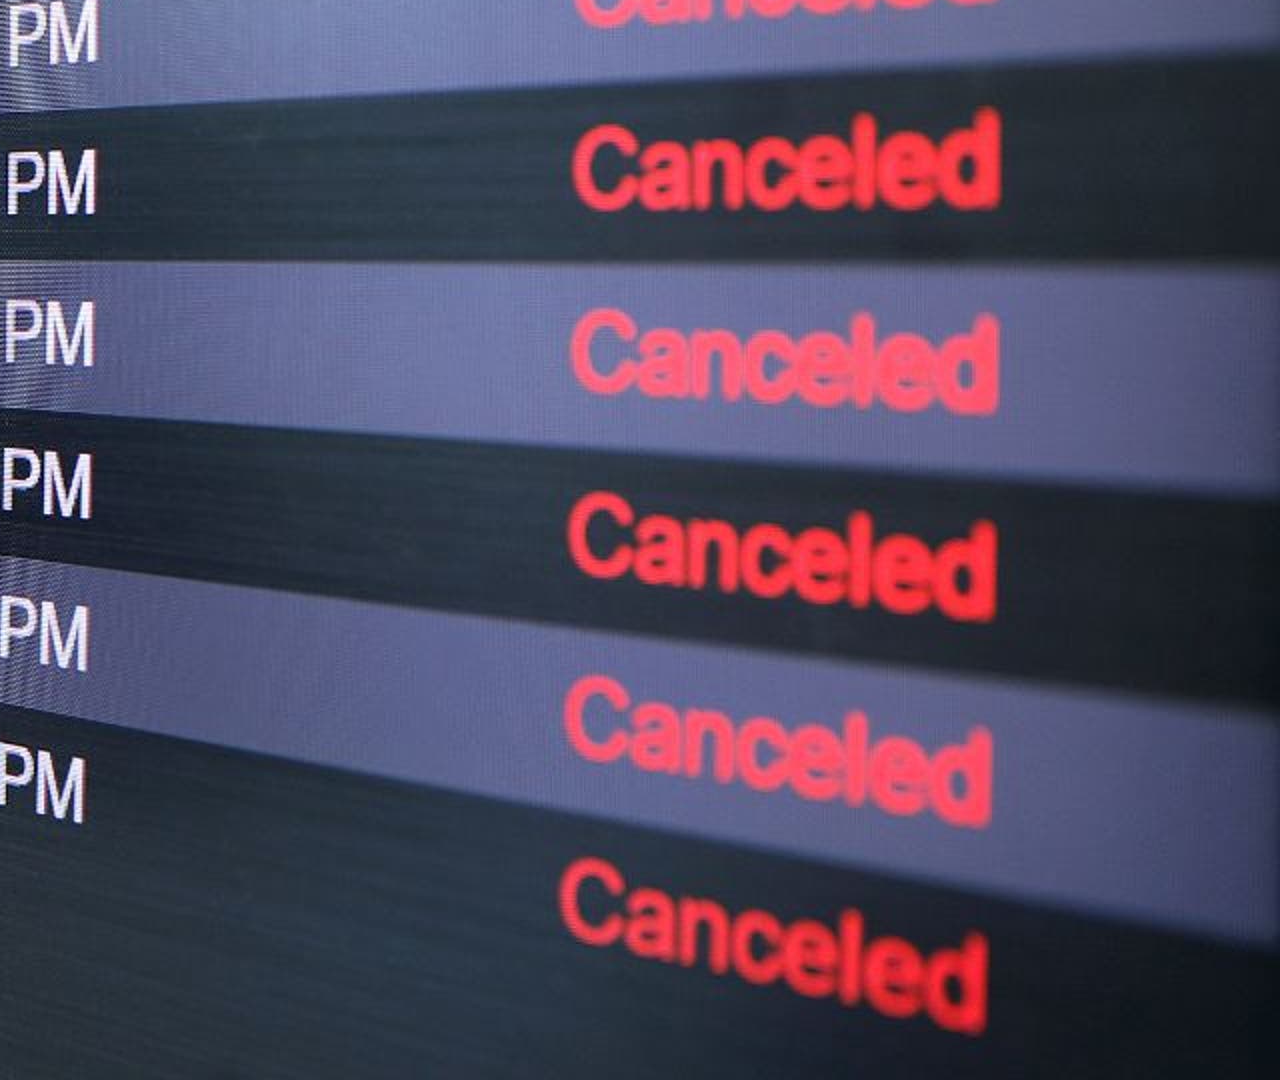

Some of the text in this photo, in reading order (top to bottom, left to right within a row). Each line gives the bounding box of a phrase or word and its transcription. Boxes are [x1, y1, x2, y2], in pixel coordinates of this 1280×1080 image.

[7, 148, 98, 216] PM
[571, 106, 1003, 212] Canceled
[4, 298, 96, 367] PM
[571, 309, 999, 414] Canceled
[2, 447, 93, 520] PM
[567, 491, 999, 622] Canceled
[565, 676, 993, 827] Canceled
[559, 857, 990, 1033] Canceled
